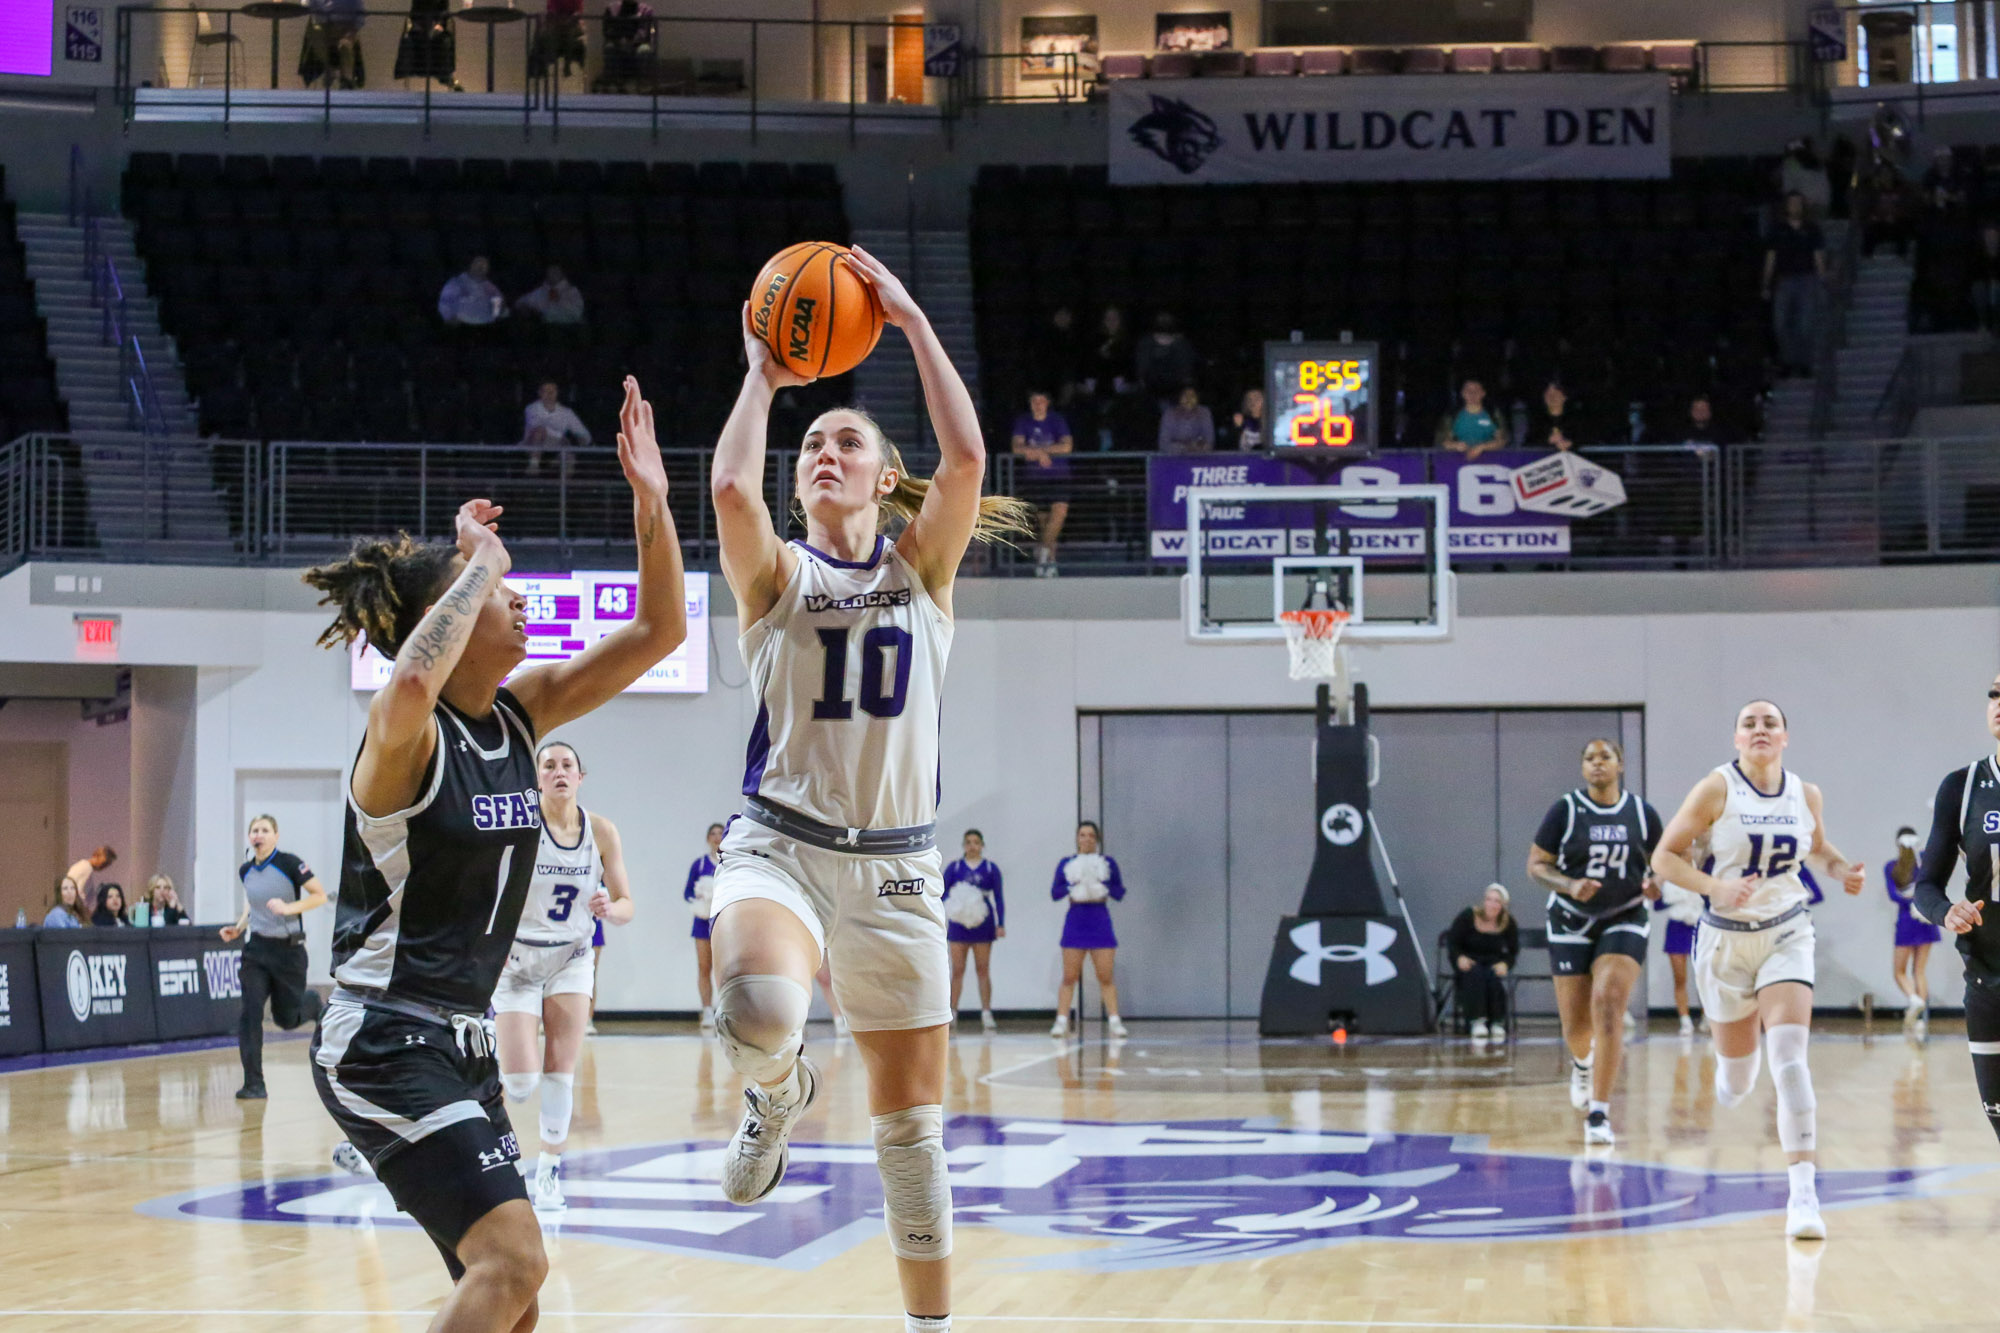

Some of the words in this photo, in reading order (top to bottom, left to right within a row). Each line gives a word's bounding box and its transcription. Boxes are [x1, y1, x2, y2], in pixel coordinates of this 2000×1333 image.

[70, 43, 98, 60] 115
[1243, 109, 1517, 151] WILDCAT
[1544, 107, 1656, 147] DEN
[755, 272, 787, 338] ilson
[788, 296, 816, 362] NCAA
[1299, 360, 1362, 391] 8:55
[1290, 393, 1353, 445] 26
[1190, 465, 1249, 486] THREE
[1457, 463, 1516, 516] 6
[1160, 534, 1279, 550] WDCAT
[1295, 532, 1420, 550] SDENT
[1448, 532, 1558, 548] SECTION
[598, 586, 629, 613] 43
[83, 620, 114, 643] EXIT
[405, 613, 453, 671] Love
[647, 668, 680, 678] OULS
[811, 626, 913, 721] 10
[1585, 844, 1629, 879] 24
[1741, 833, 1798, 878] 12
[484, 844, 515, 935] 1
[546, 883, 579, 922] 3
[877, 877, 925, 897] ACU
[88, 954, 127, 998] KEY
[158, 958, 199, 997] ESPN
